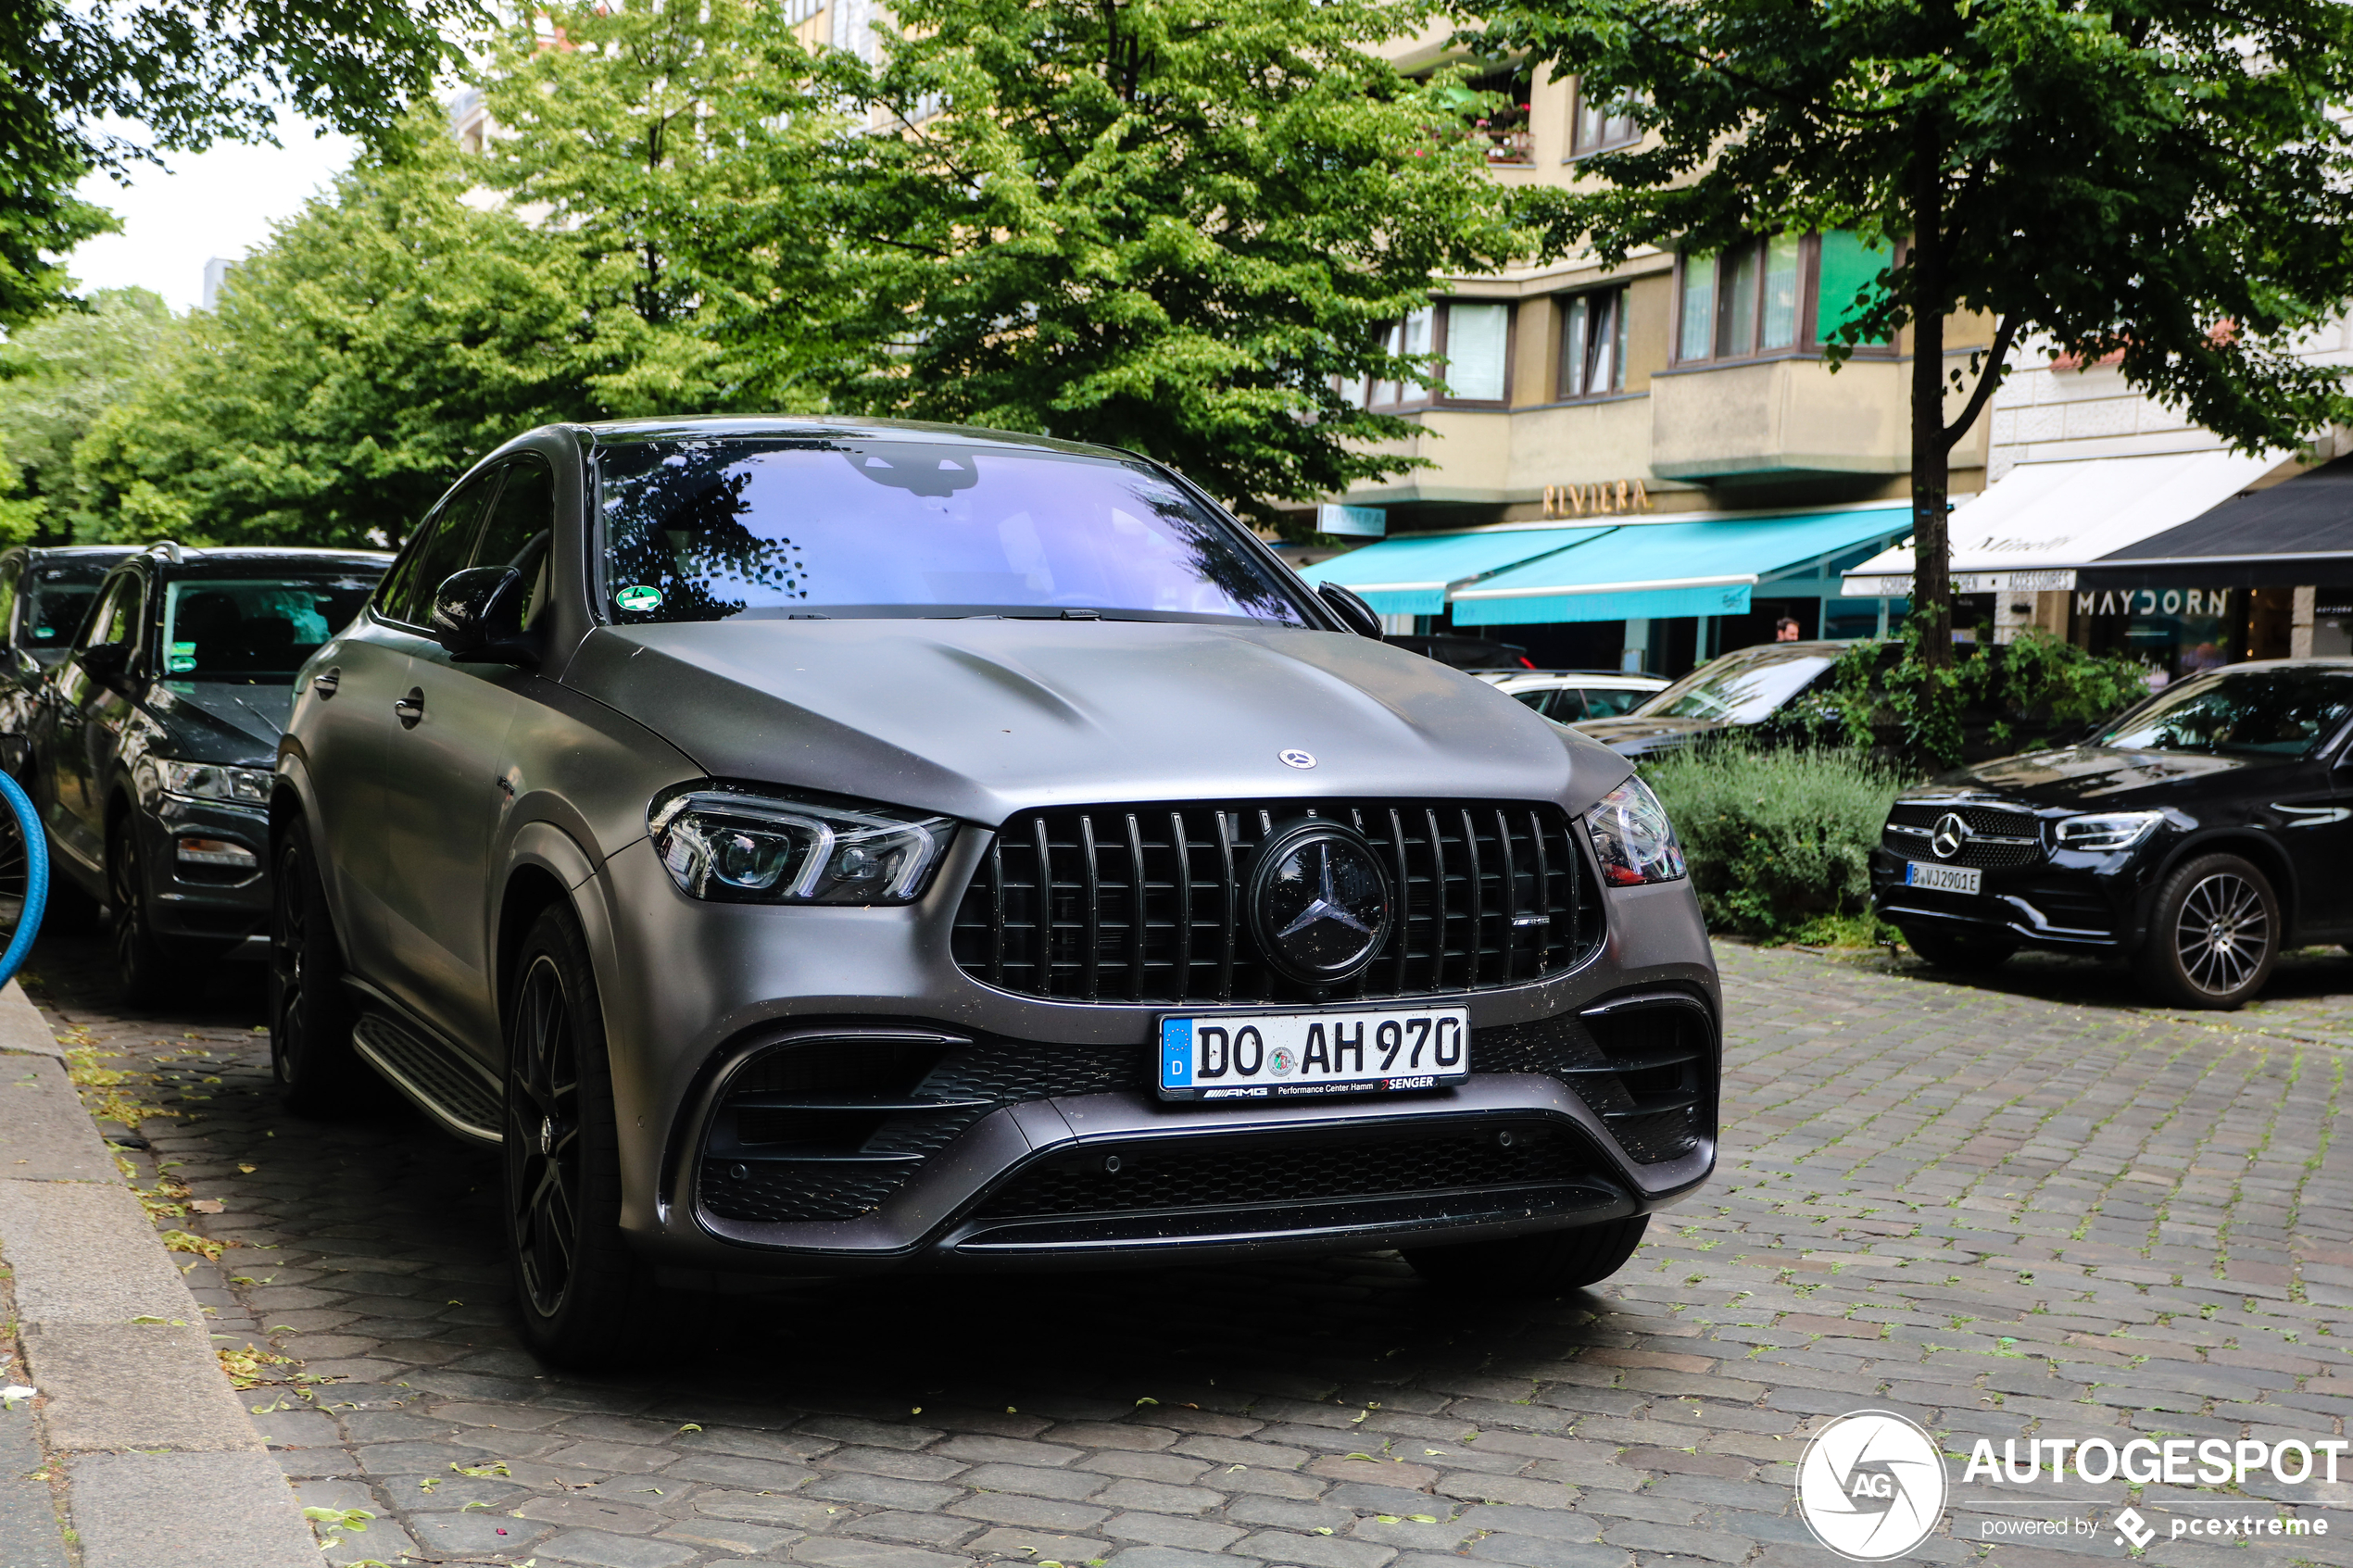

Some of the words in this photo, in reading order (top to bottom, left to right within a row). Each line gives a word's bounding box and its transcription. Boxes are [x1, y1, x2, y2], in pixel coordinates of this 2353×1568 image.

[1542, 478, 1648, 515] RIVIERA
[2076, 588, 2227, 618] MAYDORN
[1913, 867, 1919, 884] B
[1198, 1025, 1264, 1078] DO
[1301, 1022, 1365, 1074] AH
[1375, 1016, 1461, 1071] 970
[1172, 1060, 1183, 1075] D
[1277, 1085, 1325, 1096] Performance
[1325, 1084, 1350, 1093] Center
[1351, 1083, 1374, 1091] Hamm
[1388, 1076, 1434, 1090] SENGER
